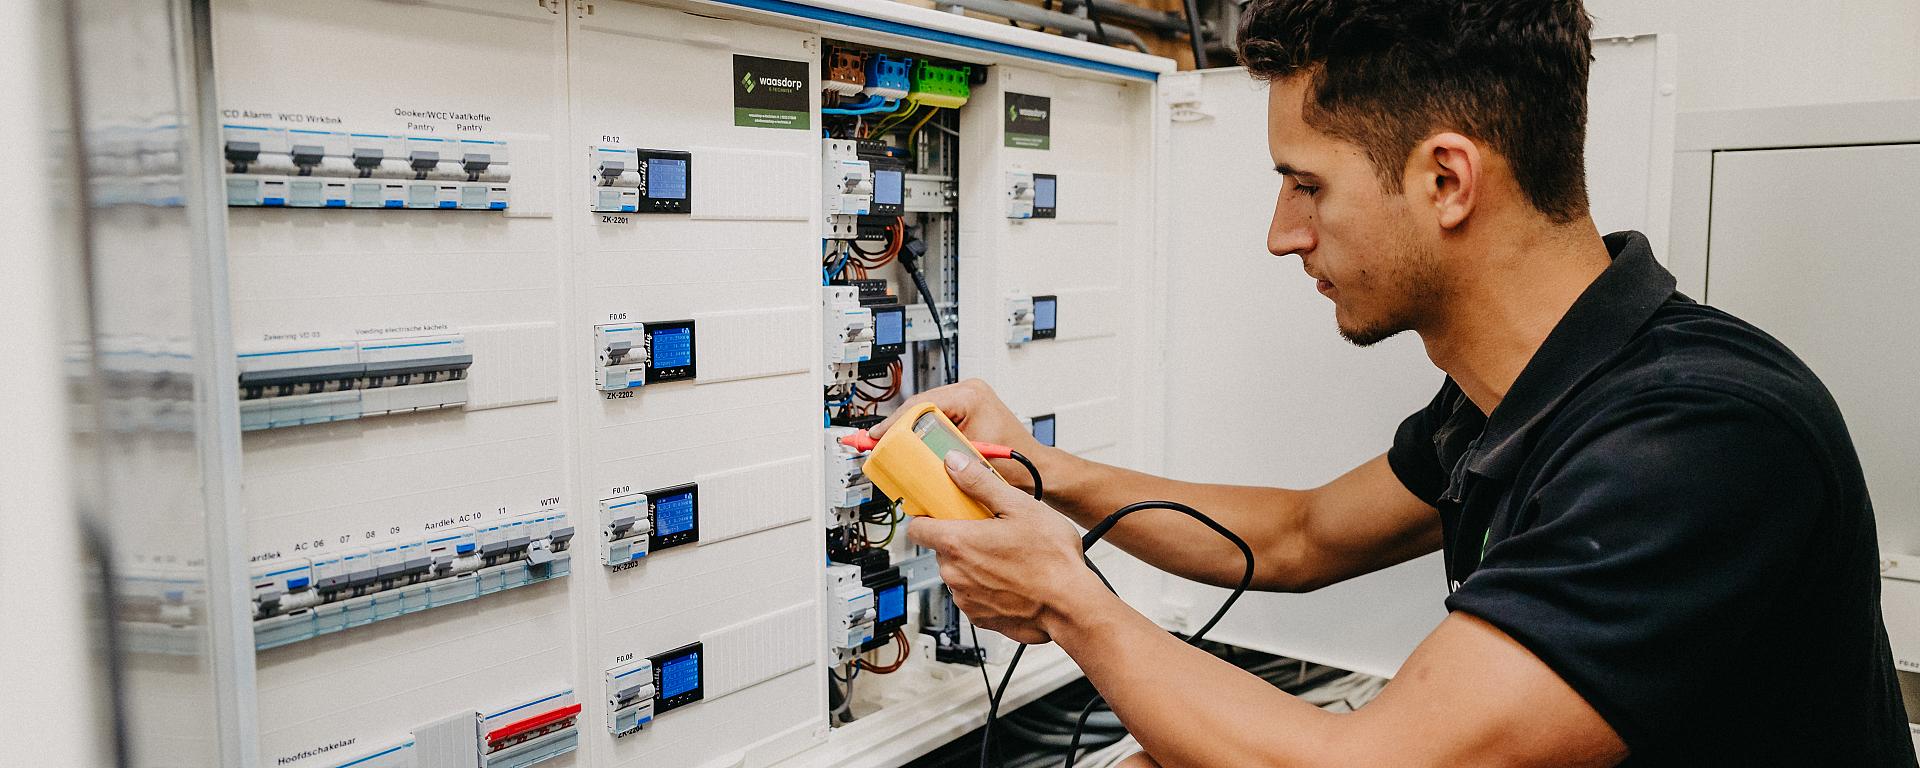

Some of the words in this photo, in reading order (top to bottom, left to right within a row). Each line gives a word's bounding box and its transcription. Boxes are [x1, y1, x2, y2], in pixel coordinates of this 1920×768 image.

[759, 77, 803, 91] waasdorp
[223, 109, 240, 119] CD
[407, 122, 435, 133] Pantry
[456, 123, 483, 132] Pantry
[602, 135, 620, 143] F0.12
[602, 215, 629, 224] ZK-2201
[606, 391, 634, 400] ZK-2202
[612, 485, 630, 495] F0.10
[540, 496, 560, 507] WTW
[498, 507, 507, 515] 11
[424, 516, 455, 531] Aardlek
[459, 513, 470, 522] AC
[472, 511, 482, 520] 10
[365, 530, 376, 539] 08
[390, 525, 400, 535] 09
[340, 534, 351, 544] 07
[294, 542, 308, 551] AC
[250, 551, 281, 563] ardlek
[612, 560, 639, 573] ZK-2203
[277, 737, 356, 766] Hoofdschakelaar
